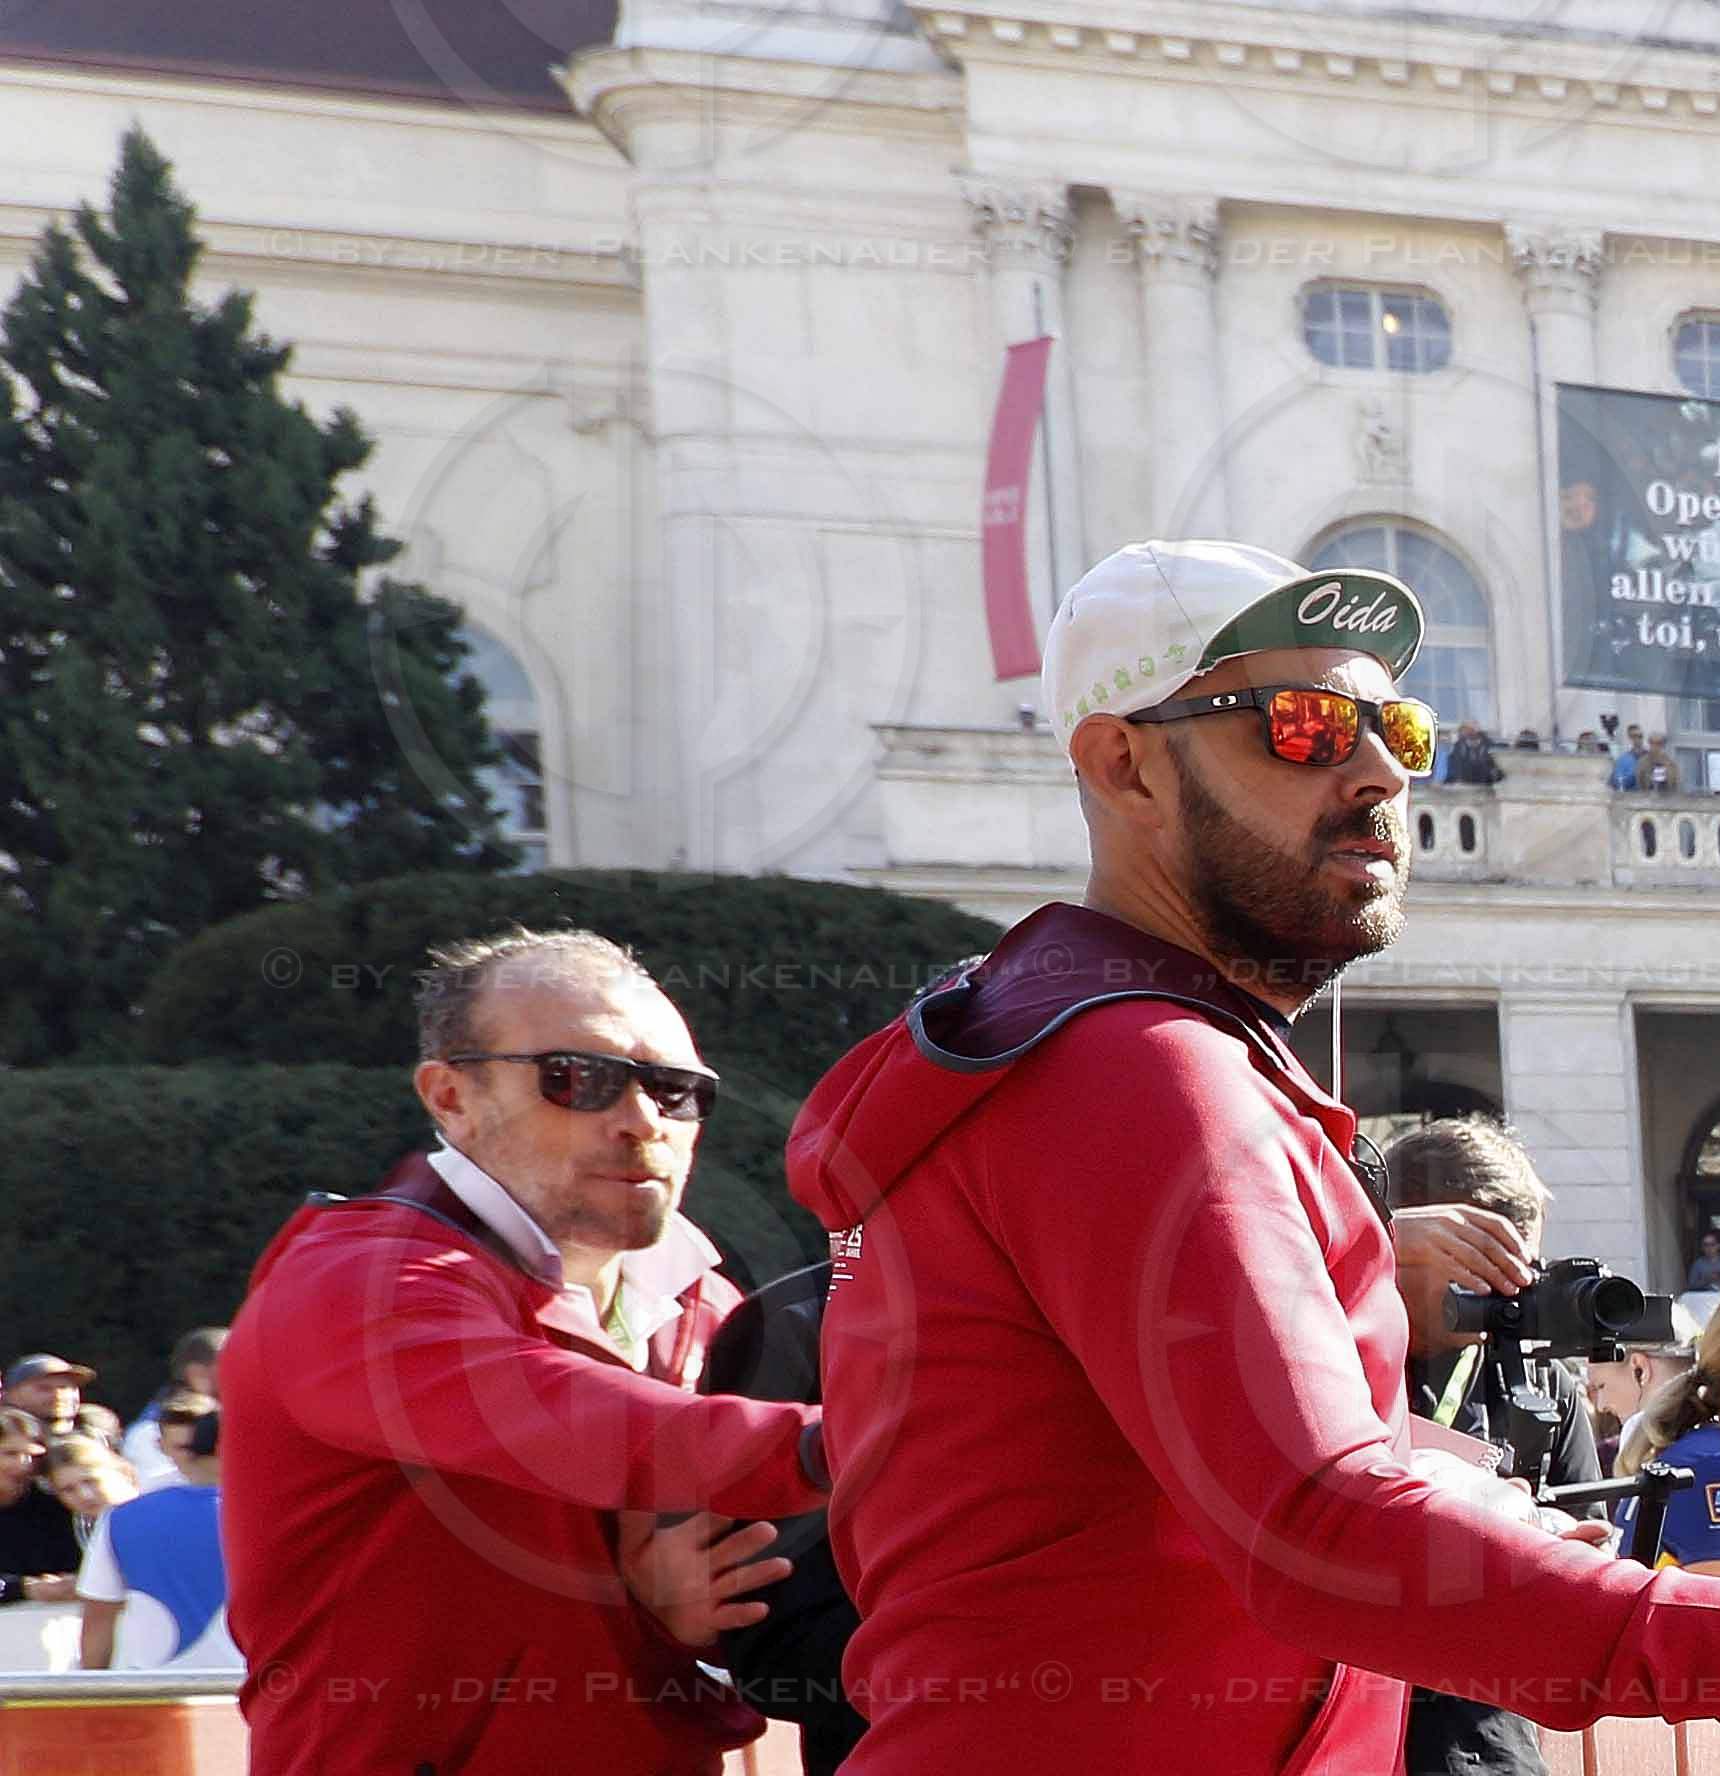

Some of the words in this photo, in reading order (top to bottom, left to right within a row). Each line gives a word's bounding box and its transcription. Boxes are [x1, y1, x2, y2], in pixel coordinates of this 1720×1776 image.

[1297, 582, 1399, 633] Oida
[1611, 570, 1713, 606] allen
[1637, 613, 1705, 653] toi,
